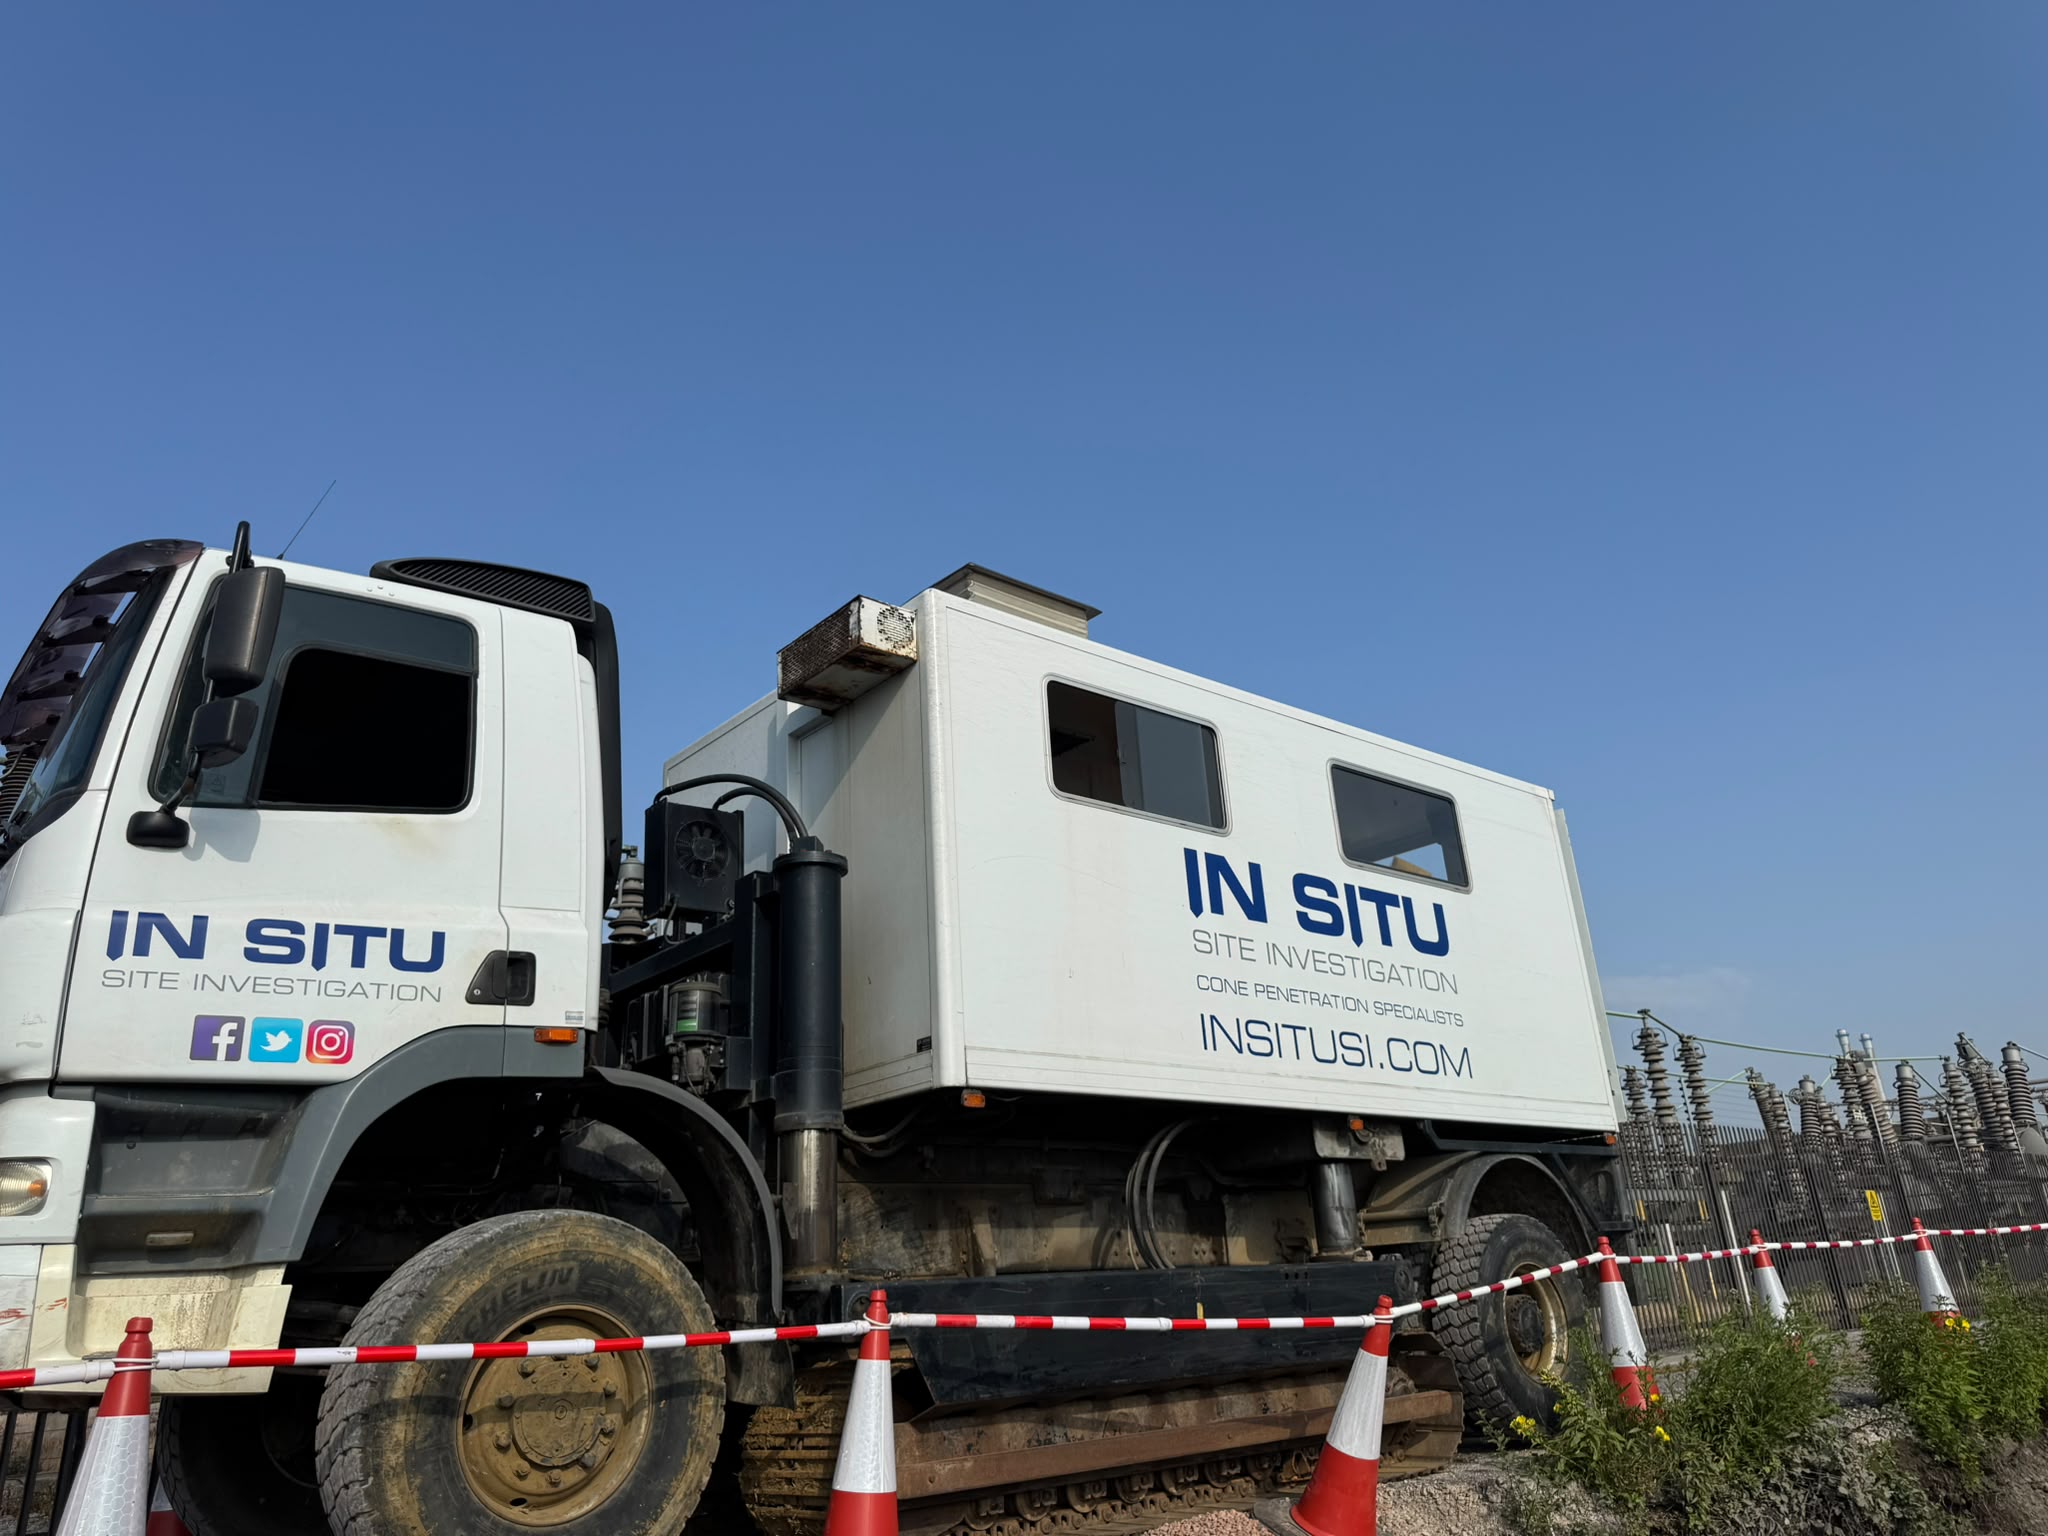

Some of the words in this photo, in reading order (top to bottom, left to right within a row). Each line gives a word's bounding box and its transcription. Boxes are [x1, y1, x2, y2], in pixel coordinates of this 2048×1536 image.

[1183, 847, 1268, 923] IN
[1292, 873, 1449, 957] SITU
[106, 910, 209, 961] IN
[243, 918, 446, 973] SITU
[1193, 929, 1257, 962] SITE
[1266, 942, 1459, 994] INVESTIGATION
[101, 969, 180, 991] SITE
[193, 973, 442, 1002] INVESTIGATION
[1197, 974, 1249, 997] CONE
[1254, 983, 1370, 1014] PENETRATION
[1373, 1001, 1464, 1027] SPECIALISTS
[1200, 1013, 1473, 1079] INSITUSI.COM
